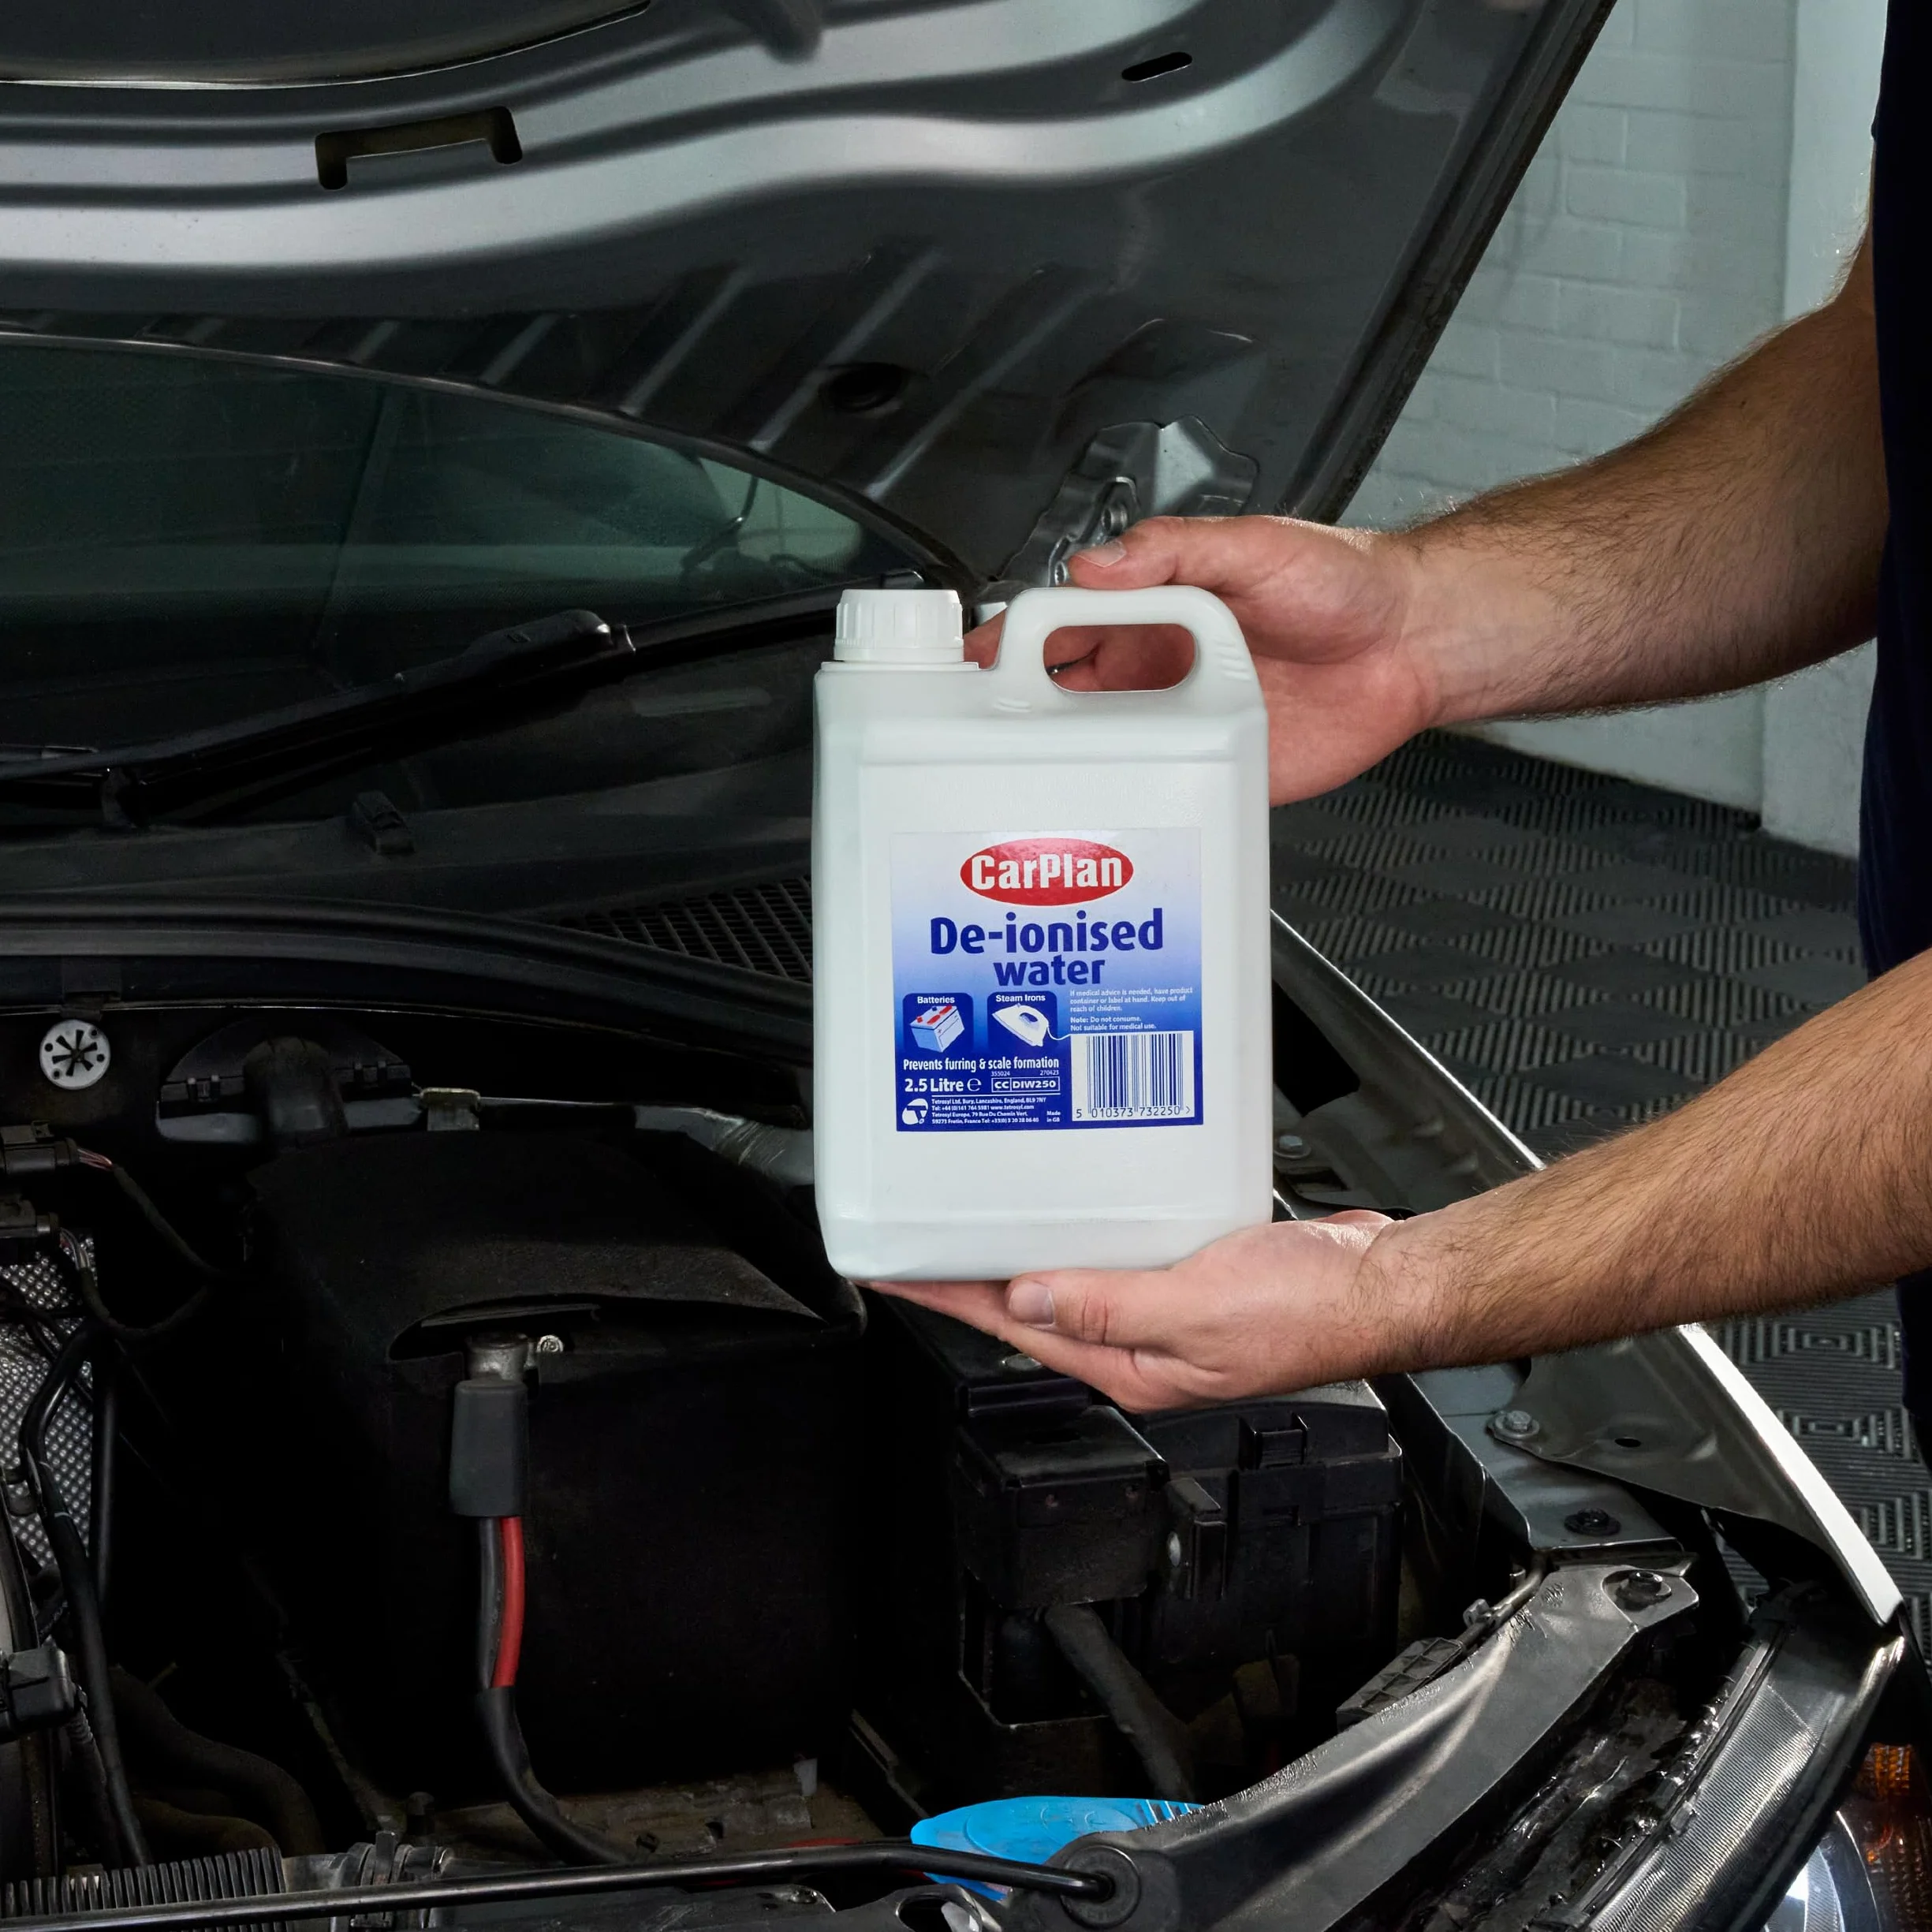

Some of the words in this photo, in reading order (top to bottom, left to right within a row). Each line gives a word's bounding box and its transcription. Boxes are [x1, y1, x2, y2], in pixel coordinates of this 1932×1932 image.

[972, 854, 1122, 890] CarPlan
[931, 908, 1163, 954] De-ionised
[993, 955, 1106, 986] water
[1169, 987, 1192, 995] product
[904, 1059, 942, 1070] Prevents
[945, 1057, 976, 1072] furring
[979, 1058, 987, 1069] &
[988, 1057, 1011, 1069] scale
[1013, 1057, 1059, 1069] formation
[904, 1078, 927, 1092] 2.5
[930, 1078, 964, 1092] Litre
[1013, 1080, 1056, 1089] DIW250
[1076, 1109, 1082, 1118] 5
[1091, 1107, 1133, 1118] 010373
[1139, 1106, 1180, 1117] 732250
